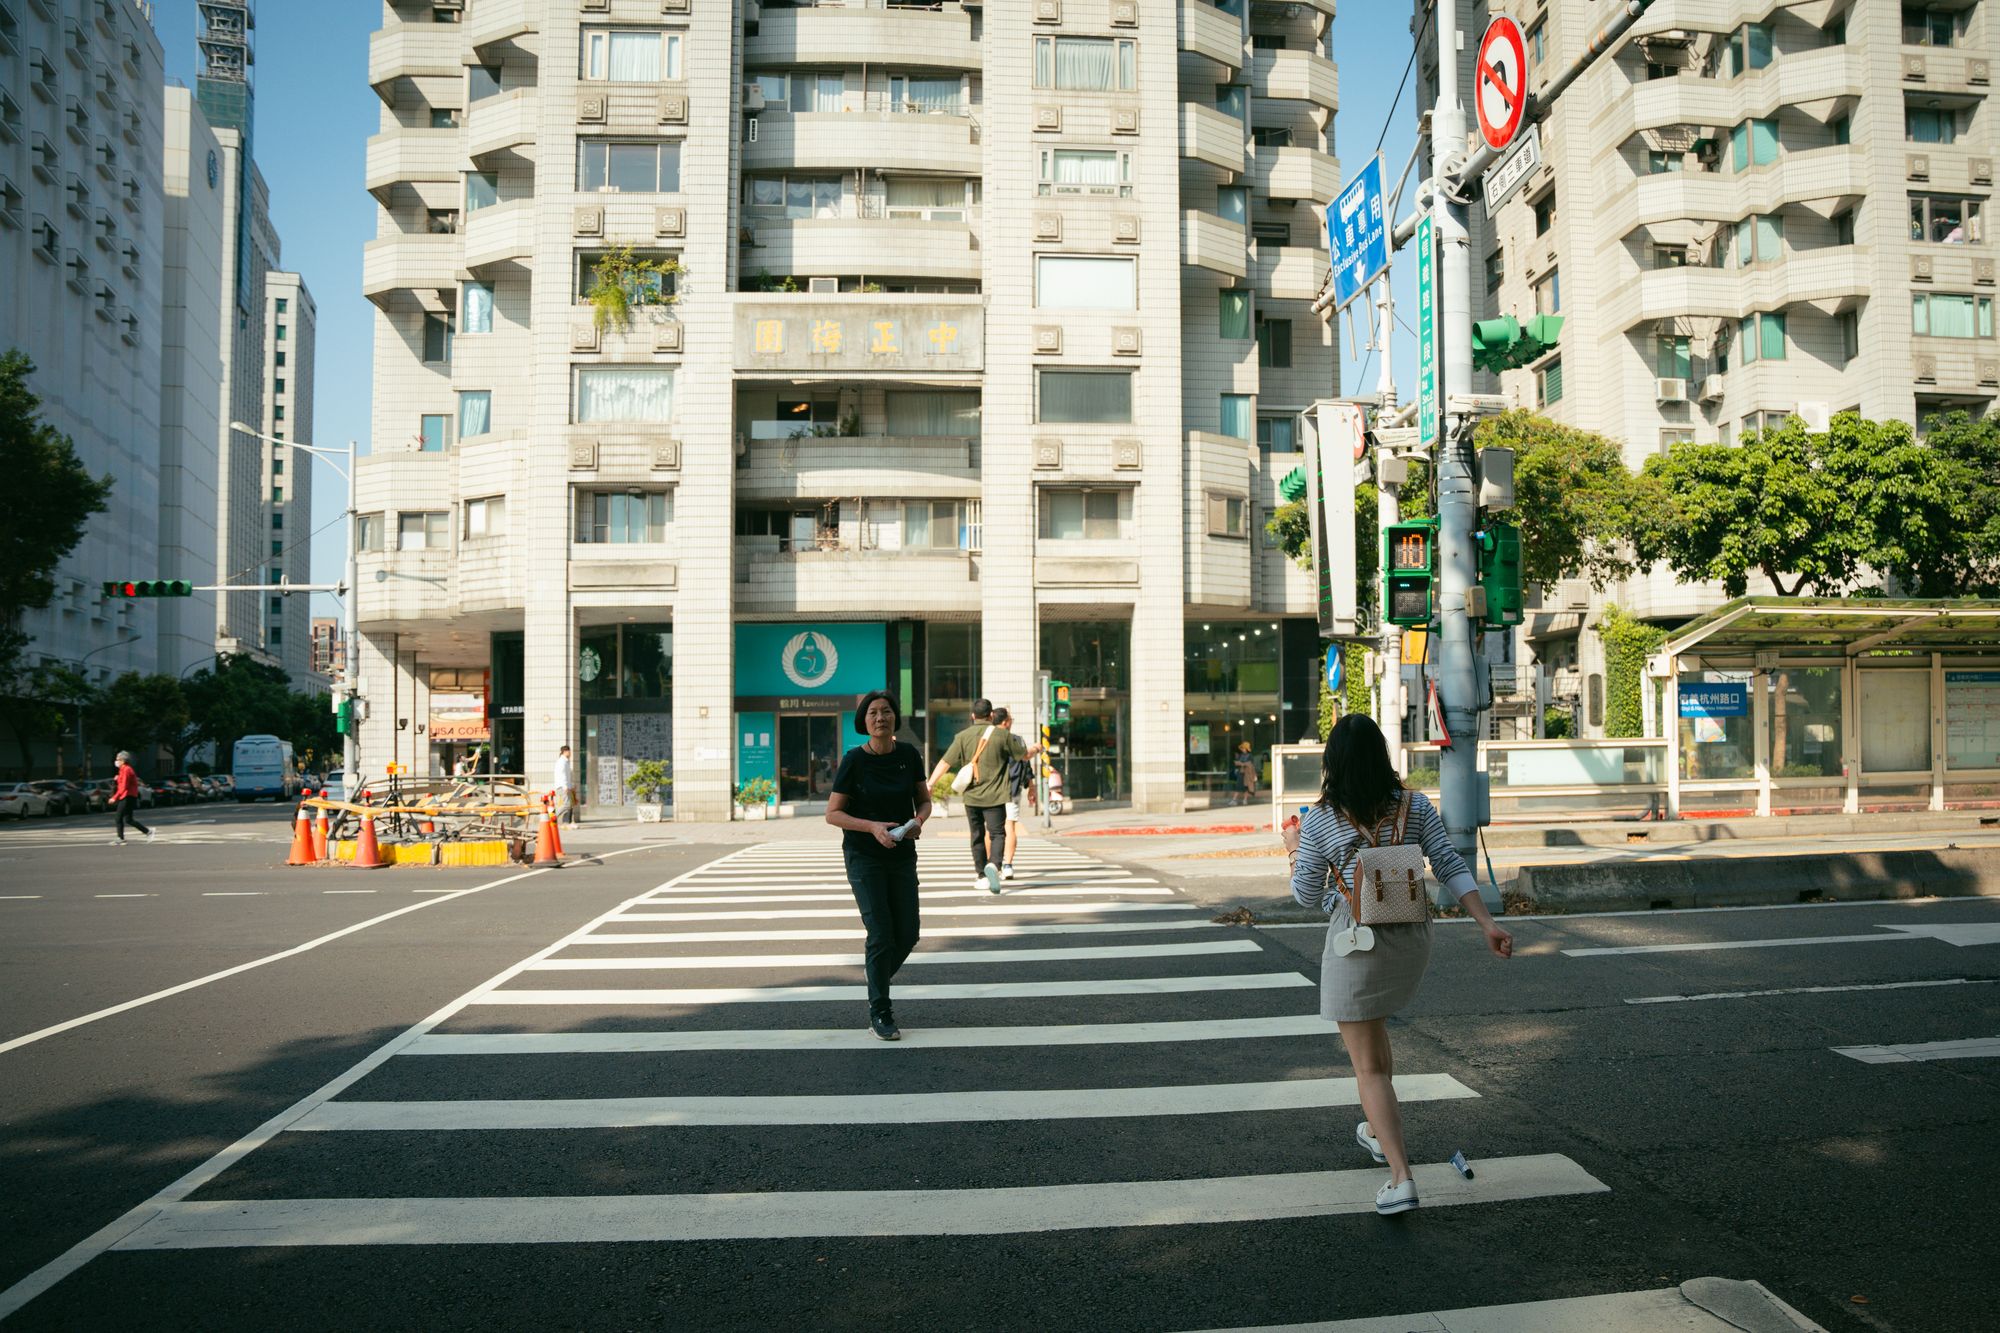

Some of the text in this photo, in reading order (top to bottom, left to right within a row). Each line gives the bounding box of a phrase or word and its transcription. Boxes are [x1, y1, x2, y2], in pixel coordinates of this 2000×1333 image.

[1332, 193, 1381, 261] 公車專用
[1334, 225, 1383, 278] Exclusive Bus Lane
[1402, 533, 1424, 567] 10
[1680, 693, 1739, 704] 信義杭州路口
